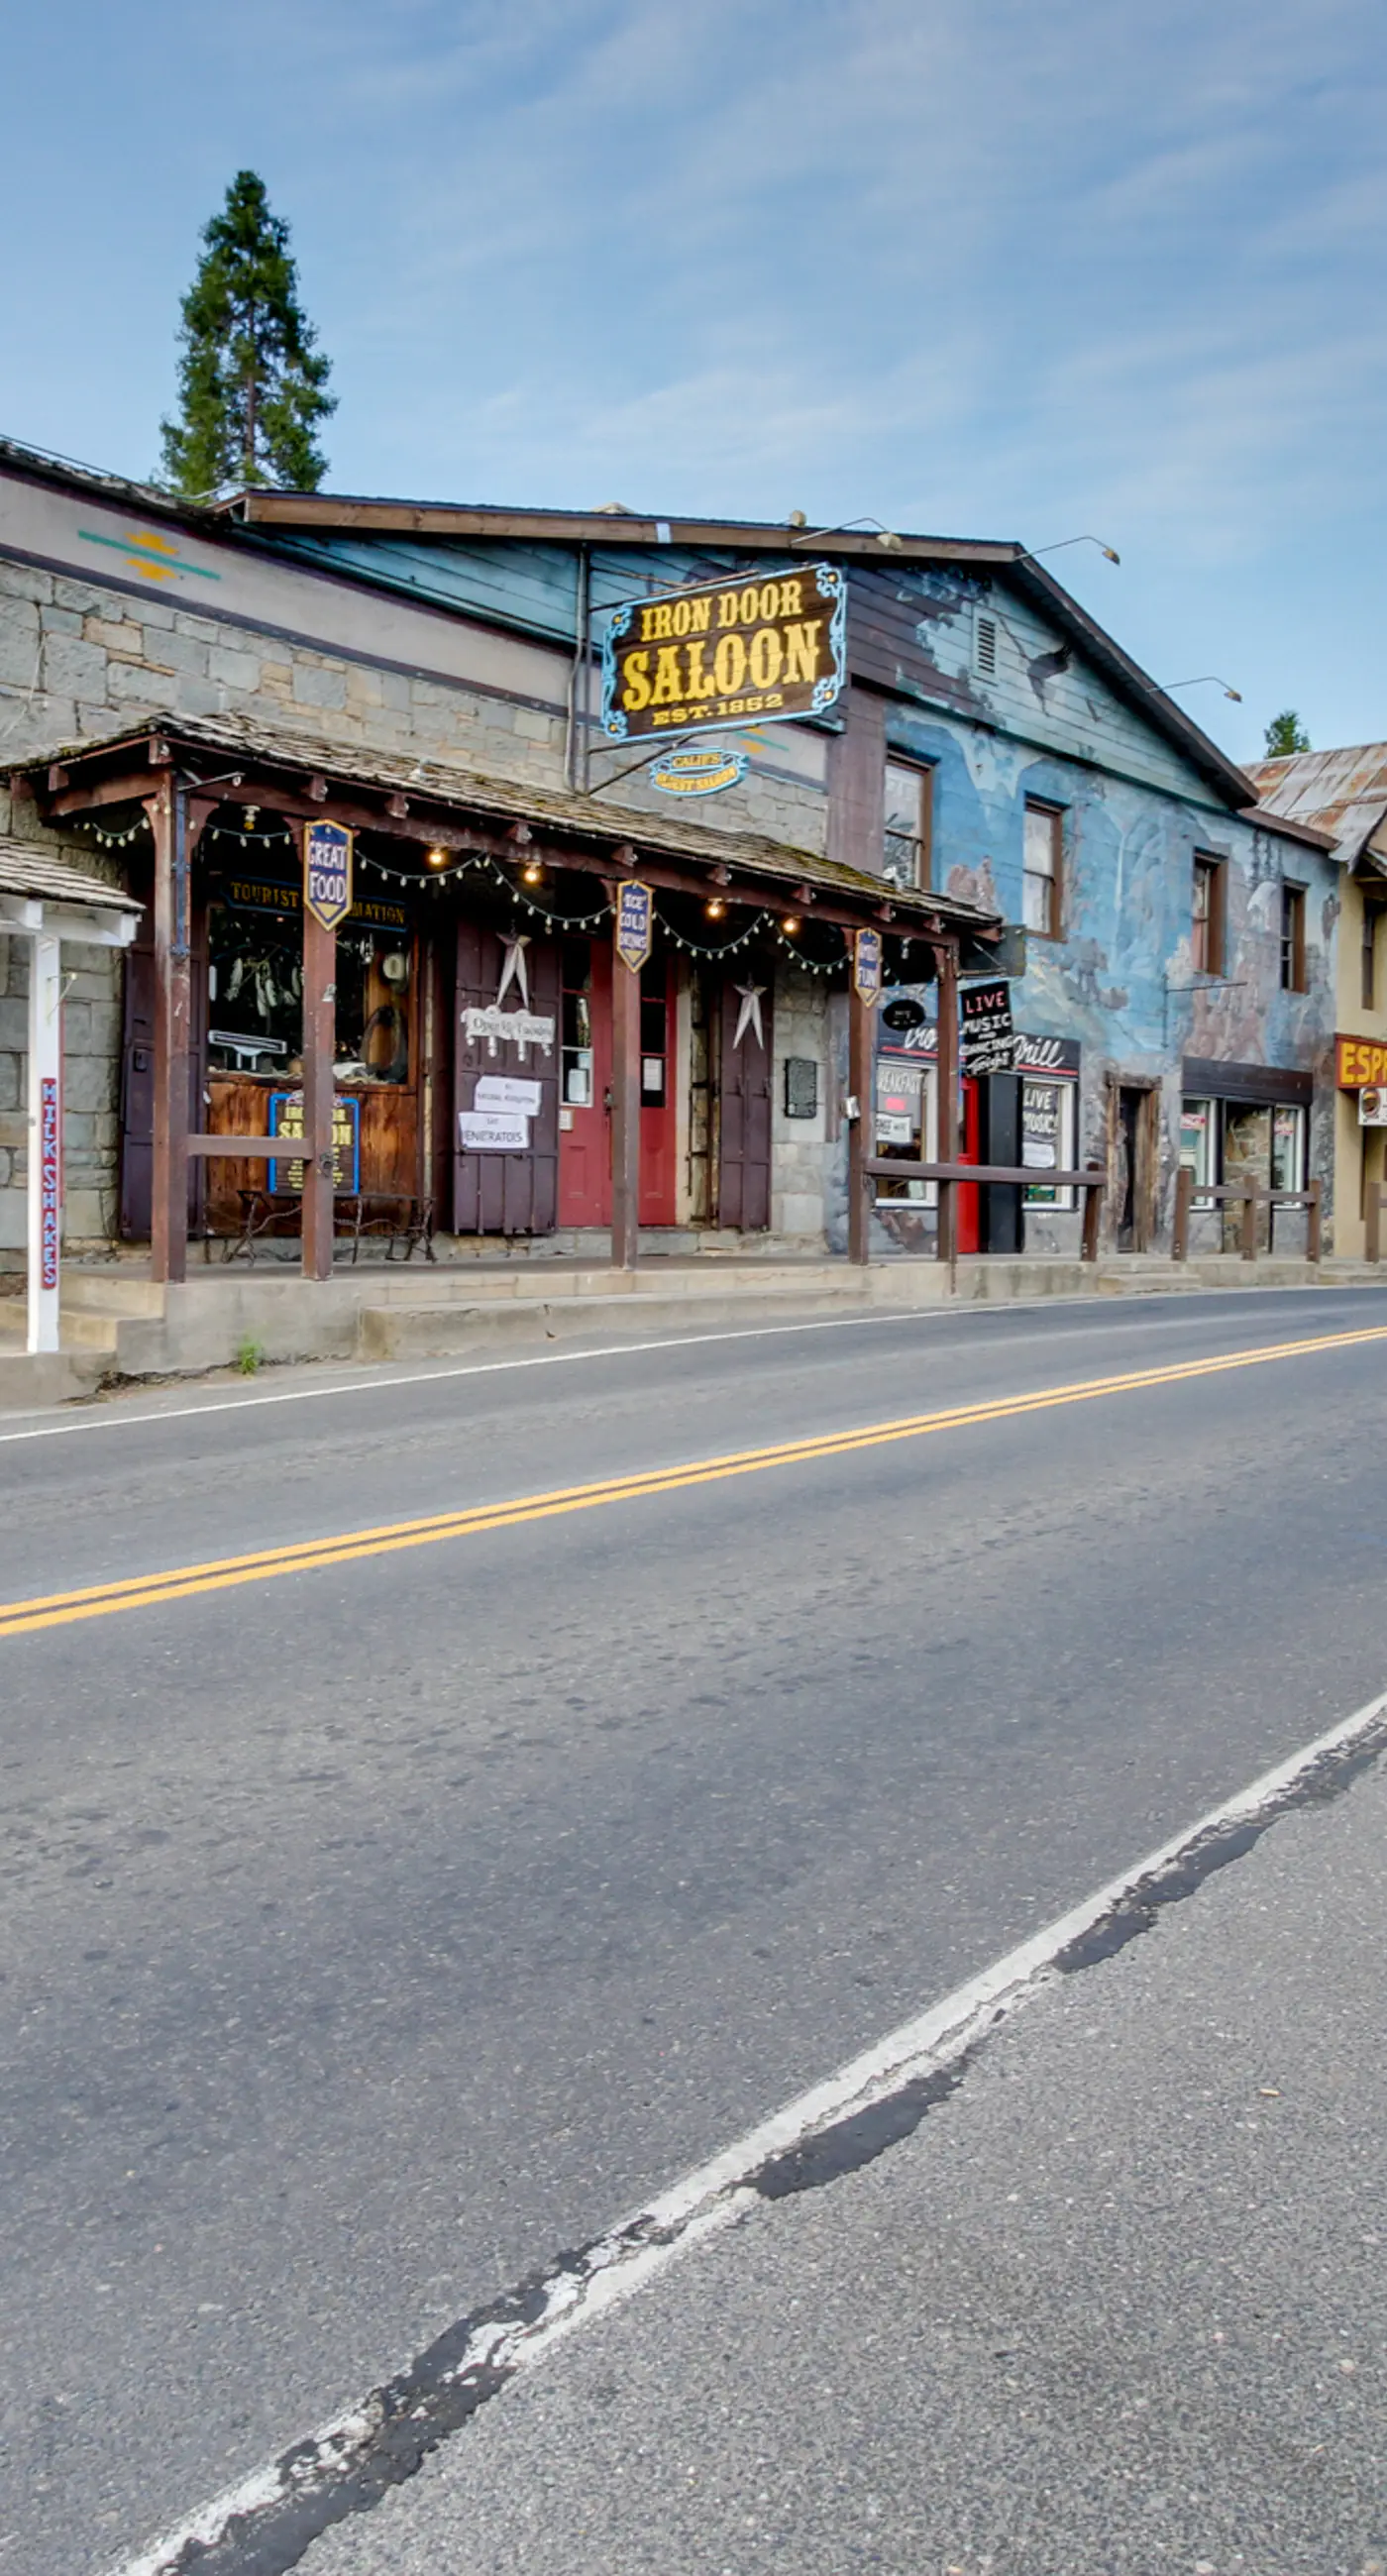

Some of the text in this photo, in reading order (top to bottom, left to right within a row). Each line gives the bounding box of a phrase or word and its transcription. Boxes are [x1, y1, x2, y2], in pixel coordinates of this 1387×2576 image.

[640, 580, 802, 642] IRON DOOR
[622, 619, 822, 712] SALOON
[308, 840, 347, 871] GREAT
[231, 881, 299, 908] TOURIST
[309, 871, 347, 903] FOOD
[620, 912, 646, 930] COLD
[965, 991, 1006, 1014] LIVE
[959, 1012, 1012, 1035] MUSIC
[1013, 1034, 1065, 1068] Grill
[1340, 1041, 1387, 1084] ESP
[1024, 1088, 1052, 1111] LIVE
